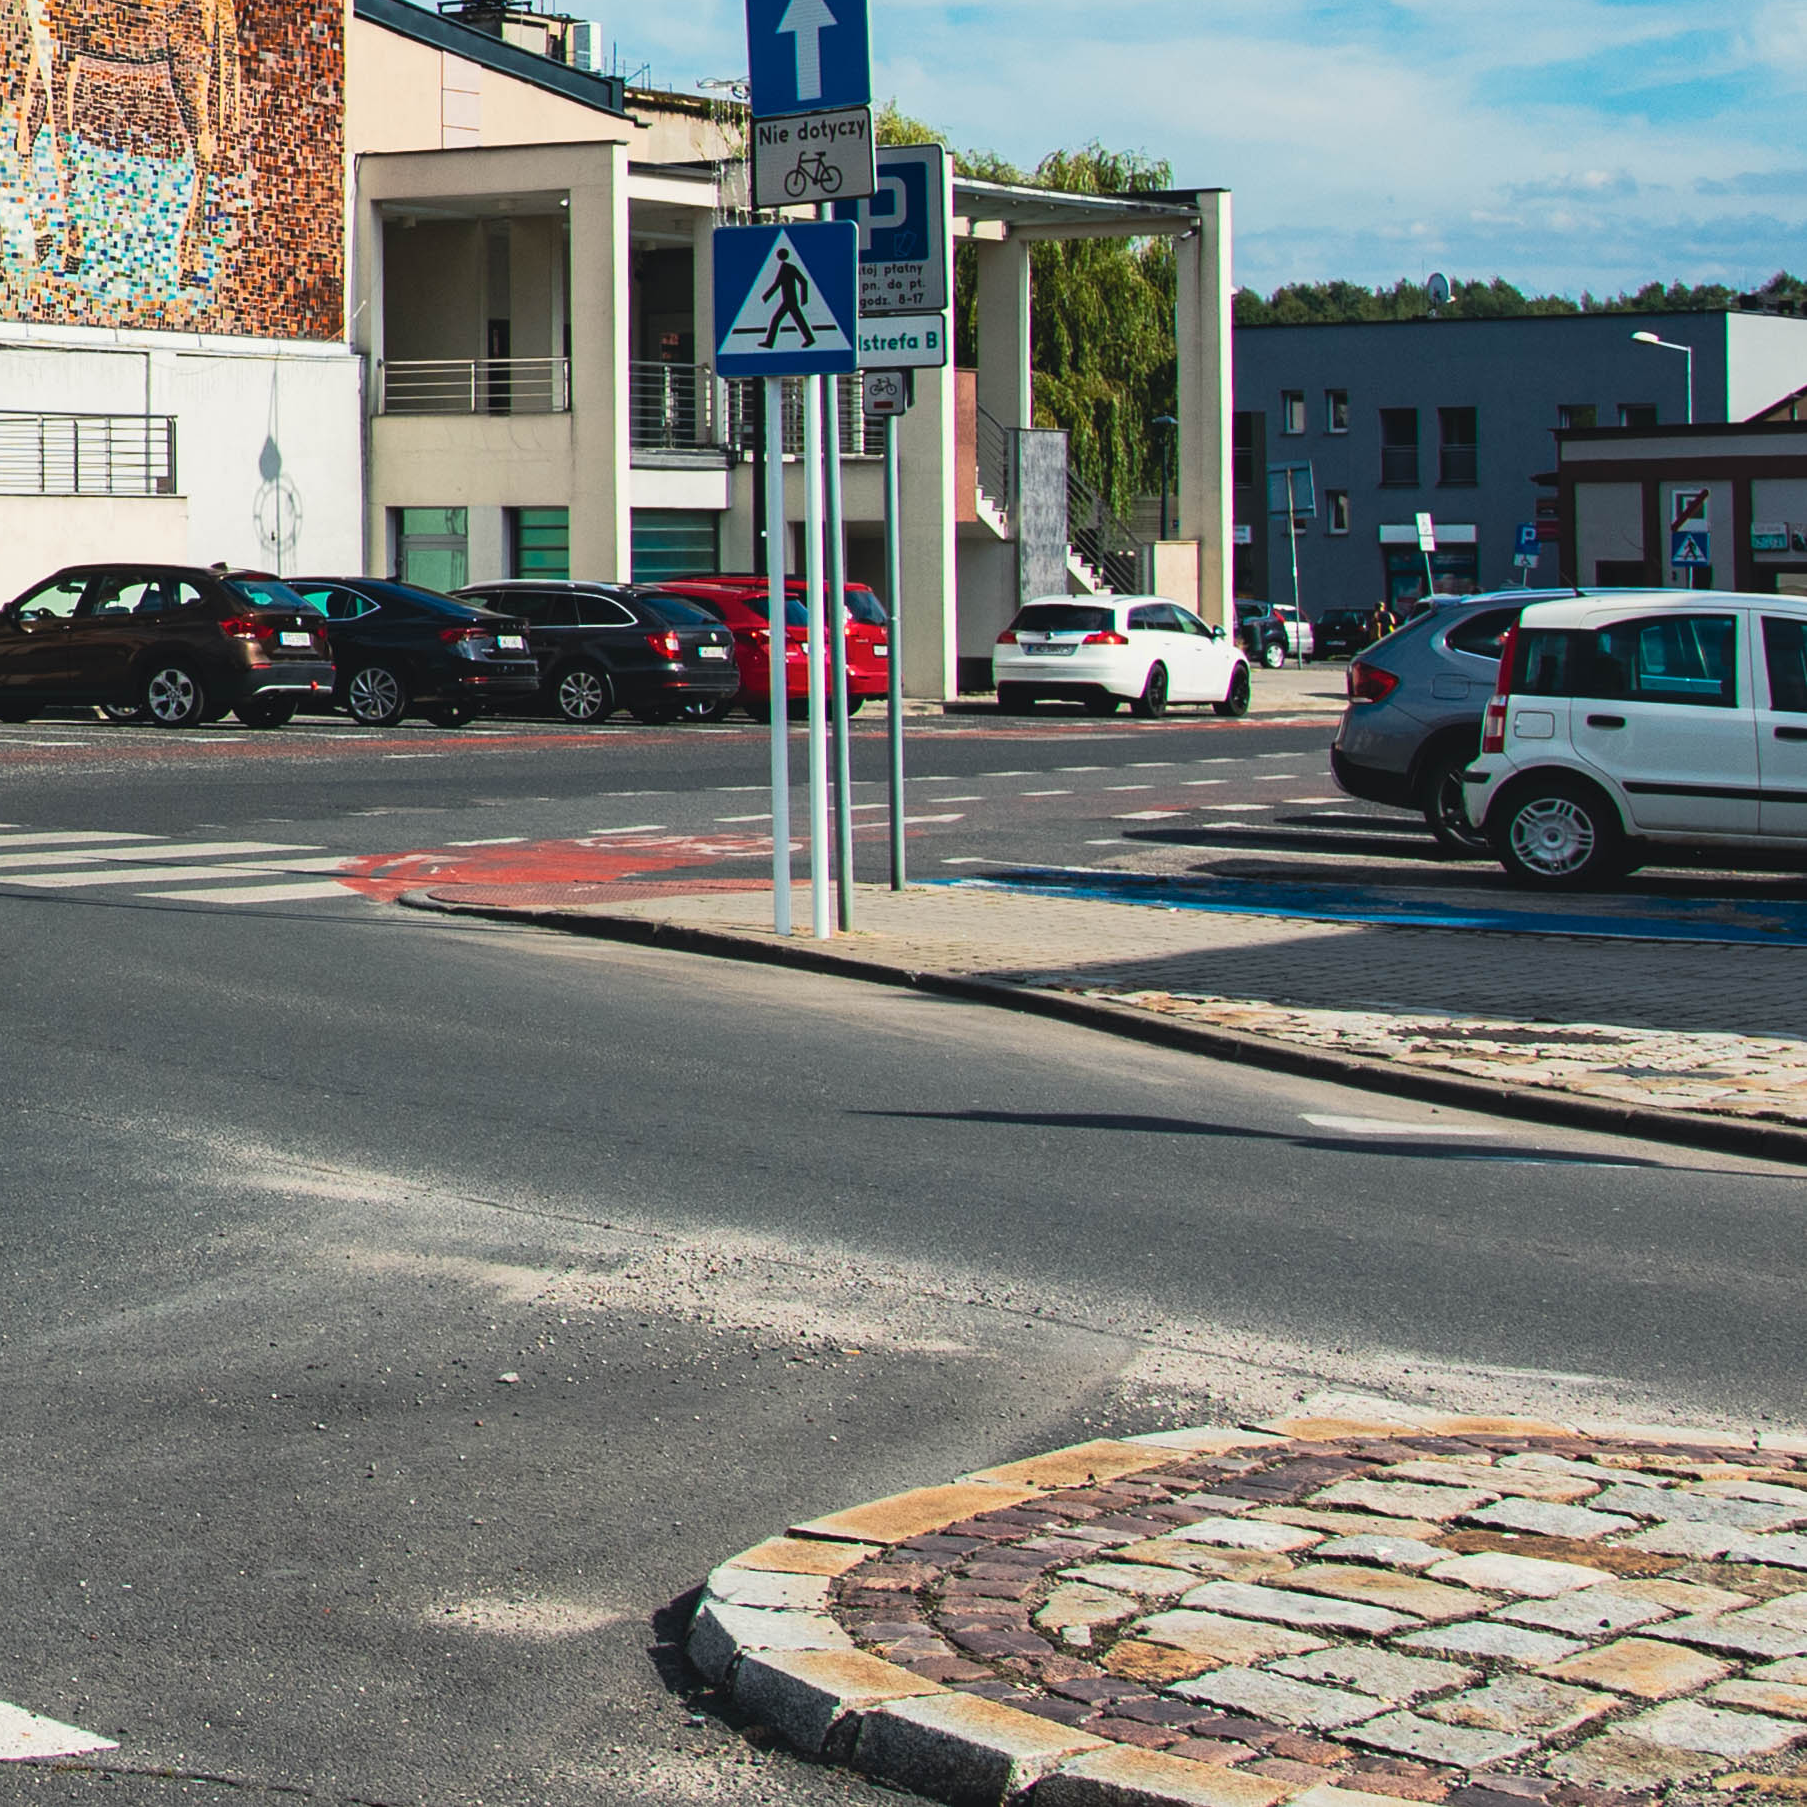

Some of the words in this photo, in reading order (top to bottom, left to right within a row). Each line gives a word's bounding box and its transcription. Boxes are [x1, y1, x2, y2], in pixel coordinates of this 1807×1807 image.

[759, 126, 789, 145] Nie
[797, 120, 866, 143] dotyczy
[858, 264, 877, 277] tój
[884, 263, 923, 277] płatny
[862, 281, 880, 293] pn.
[887, 279, 902, 289] do
[909, 279, 926, 291] pt.
[859, 295, 891, 309] godz.
[898, 293, 924, 305] 8-17
[926, 331, 938, 349] B
